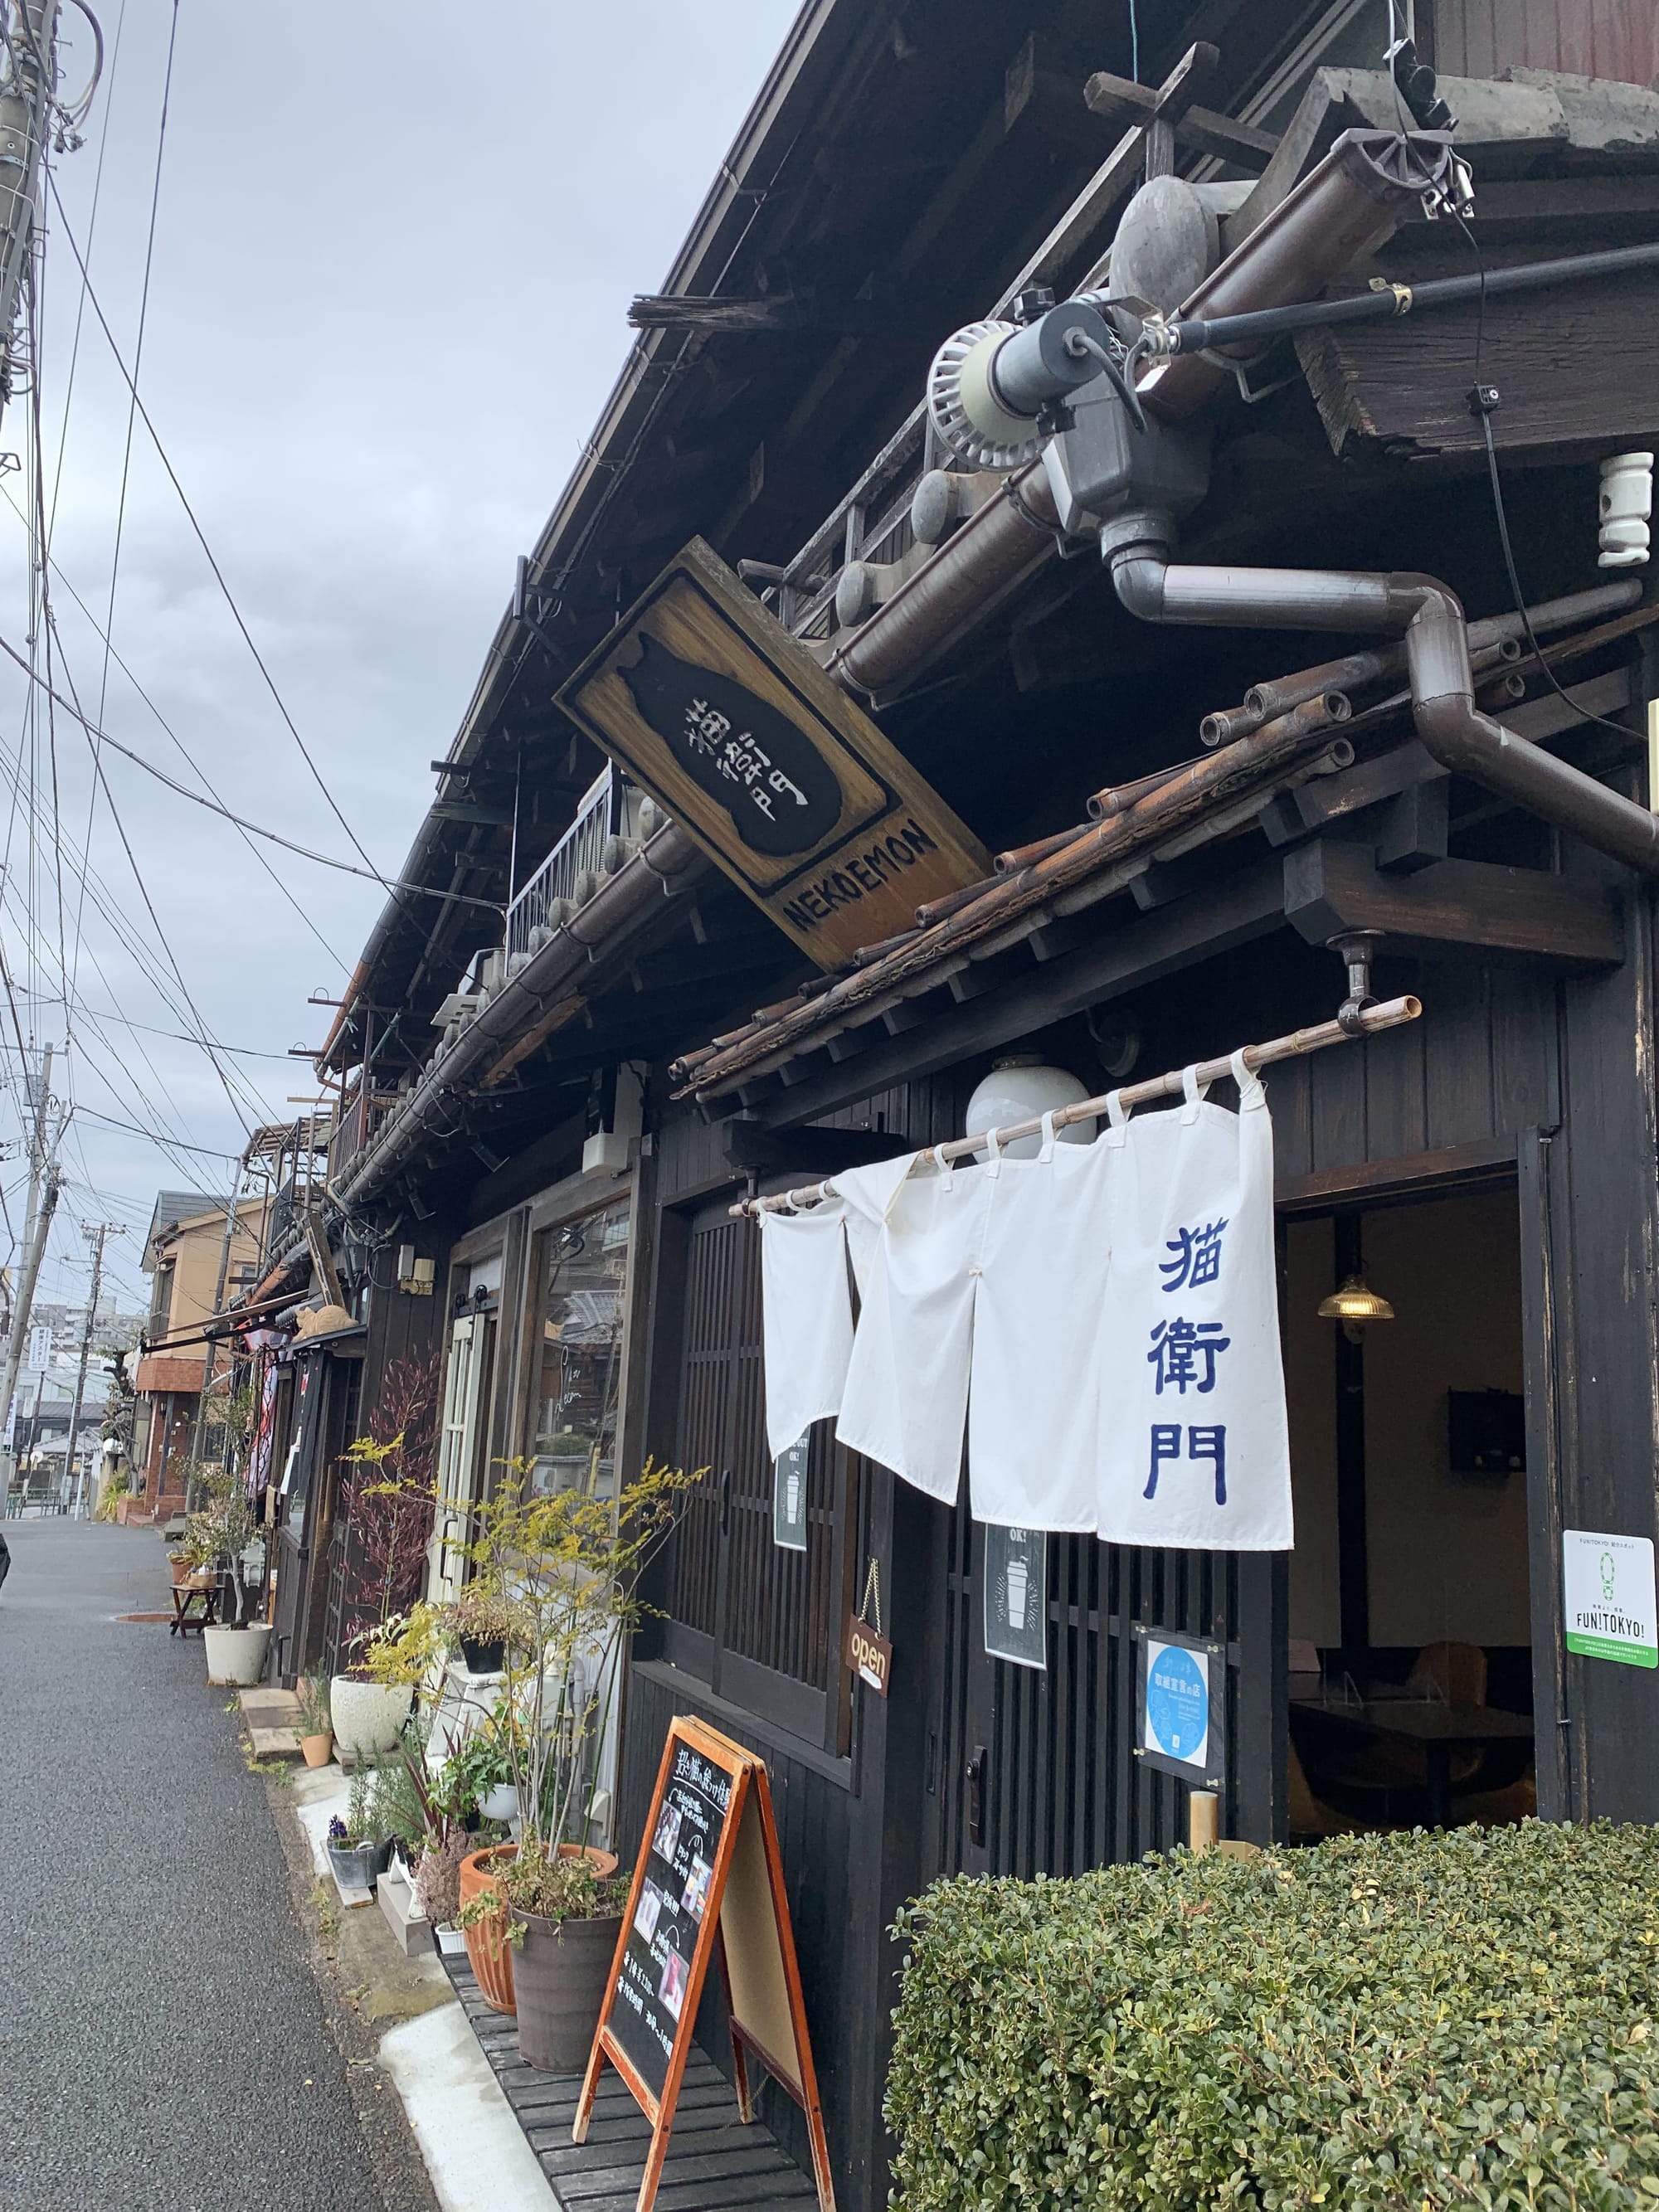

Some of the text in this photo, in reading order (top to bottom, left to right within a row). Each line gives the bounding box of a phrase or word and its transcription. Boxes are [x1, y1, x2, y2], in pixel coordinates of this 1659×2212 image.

[684, 698, 810, 822] 猫衛門
[783, 819, 938, 931] NEKOEMON
[1142, 1216, 1231, 1505] 猫衛門
[789, 1451, 800, 1461] OK!
[1010, 1528, 1027, 1543] OK!
[1577, 1612, 1645, 1638] FUN!TOKYO!
[851, 1633, 886, 1680] open
[1155, 1673, 1201, 1698] 取組宣言の店
